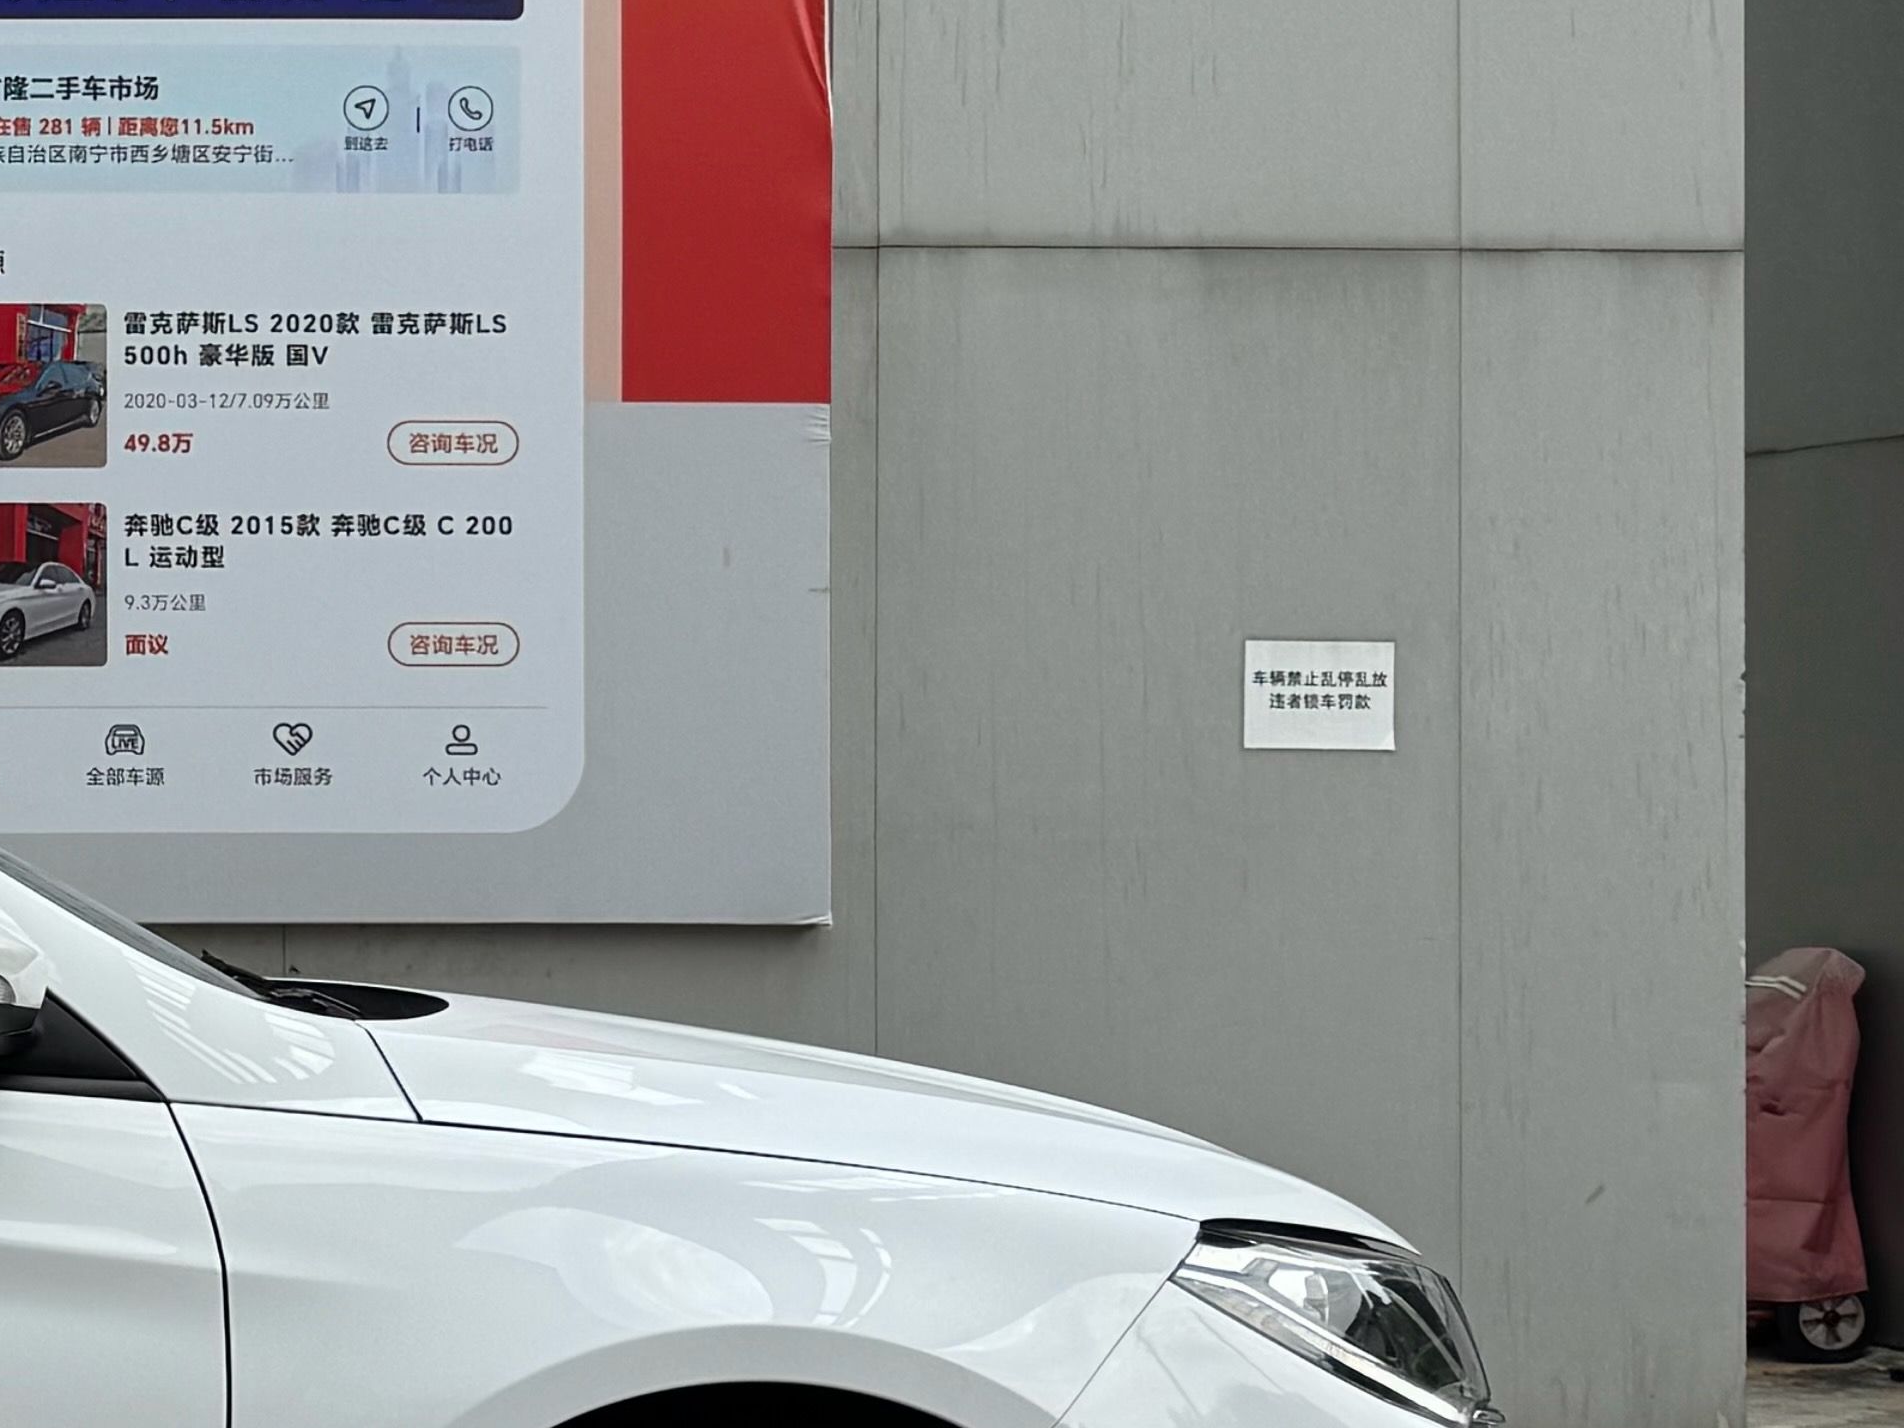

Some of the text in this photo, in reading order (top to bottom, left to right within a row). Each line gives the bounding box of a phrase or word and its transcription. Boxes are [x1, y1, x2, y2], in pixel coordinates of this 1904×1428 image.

[39, 118, 71, 135] 281
[345, 136, 388, 151] 到这去
[449, 137, 493, 151] 打电话
[124, 311, 506, 334] 雷克萨斯LS 2020款 雷克萨斯LS
[125, 343, 328, 366] 500h 豪华版 国V
[124, 393, 329, 409] 2020-03-12/7.09万公里
[124, 433, 193, 453] 49.8万
[409, 433, 498, 453] 咨询车况
[125, 514, 512, 537] 奔驰C级 2015款 奔驰C级 C 200
[125, 545, 224, 568] L 运动型
[125, 594, 205, 611] 9.3万公里
[125, 634, 168, 655] 面议
[410, 635, 498, 655] 咨询车况
[1253, 671, 1387, 687] 车辆禁止乱停乱放
[1270, 693, 1370, 709] 违者锁车罚款
[111, 736, 139, 750] LIVE
[87, 767, 164, 786] 全部车源
[255, 767, 332, 786] 市场服务
[424, 767, 501, 786] 个人中心
